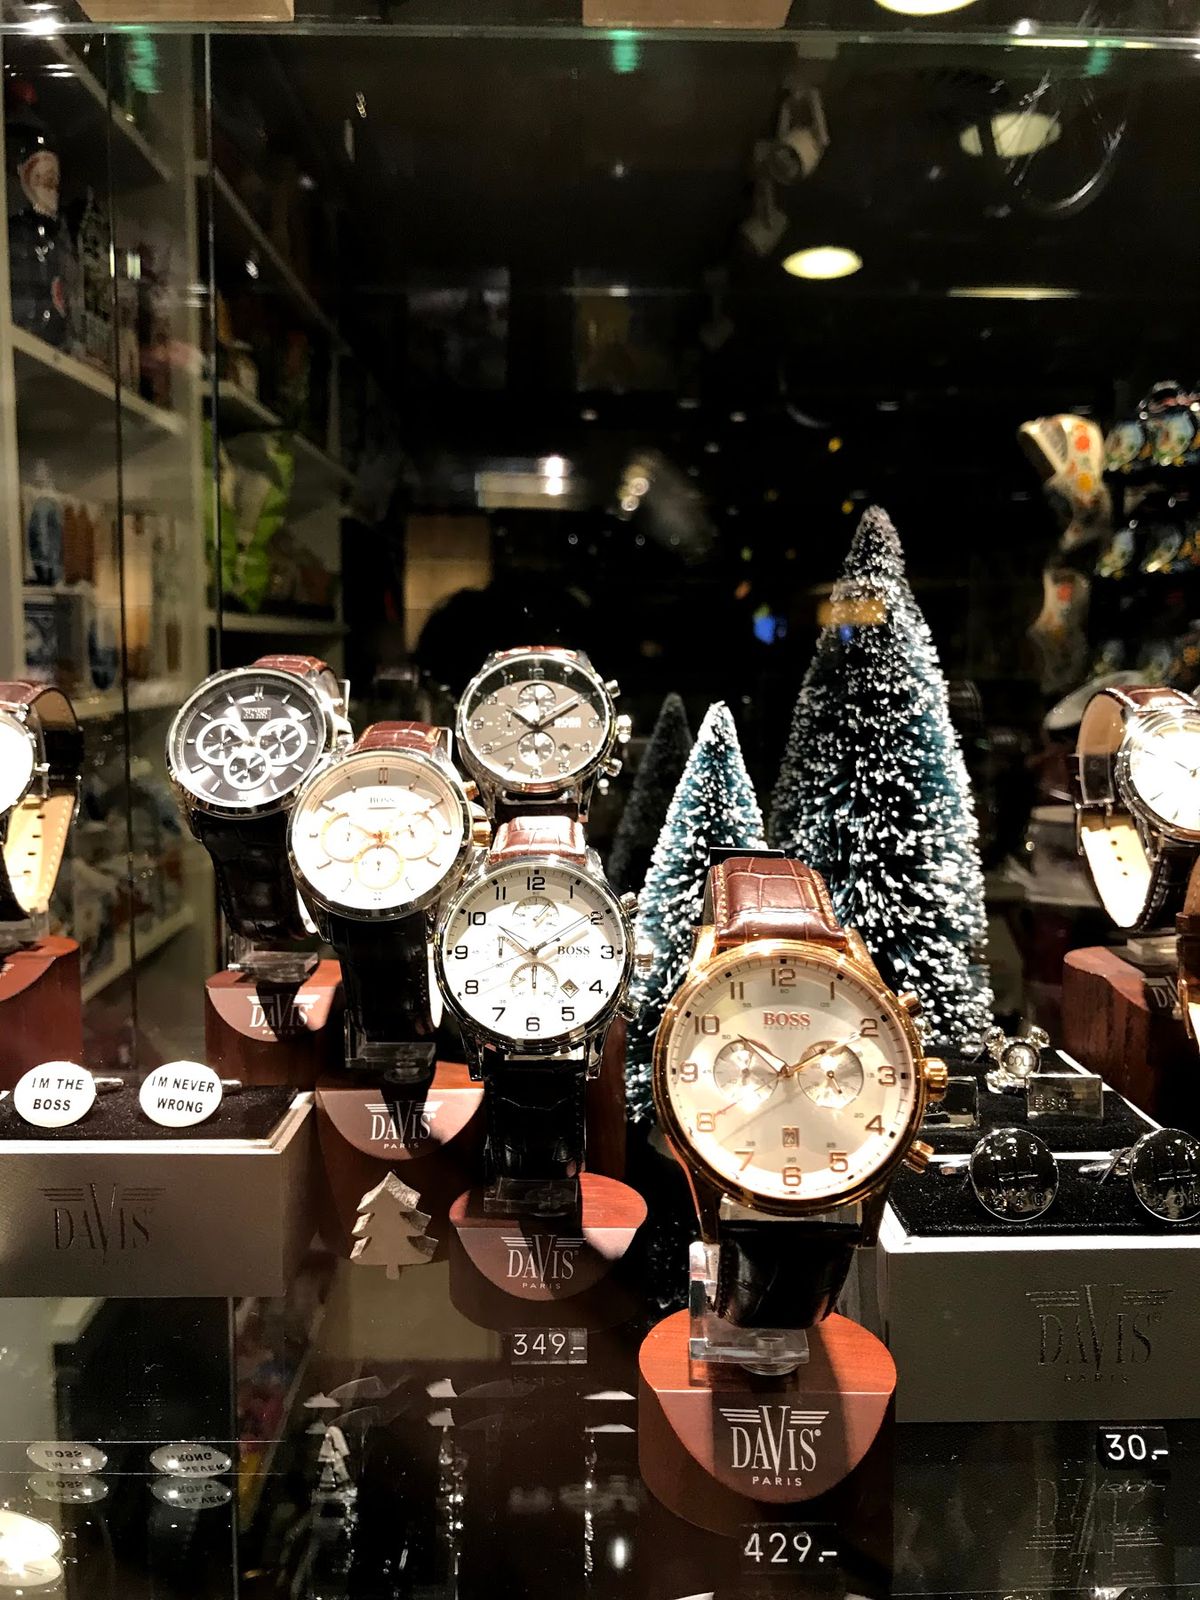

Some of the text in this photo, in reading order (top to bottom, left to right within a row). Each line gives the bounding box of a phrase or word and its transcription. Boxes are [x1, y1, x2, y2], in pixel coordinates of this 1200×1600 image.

[526, 876, 546, 891] 12
[495, 886, 507, 900] 11
[467, 911, 487, 926] 10
[590, 911, 605, 926] 2
[454, 945, 468, 960] 9
[557, 945, 591, 955] BOSS
[600, 945, 615, 960] 3
[770, 967, 797, 988] 12
[464, 979, 479, 995] 8
[588, 979, 604, 995] 4
[729, 981, 744, 1000] 11
[249, 993, 308, 1029] DAVIS
[491, 1006, 507, 1022] 7
[561, 1006, 575, 1022] 5
[762, 1011, 811, 1026] BOSS
[525, 1016, 540, 1032] 6
[694, 1014, 720, 1036] 10
[859, 1018, 880, 1038] 2
[680, 1062, 699, 1084] 9
[877, 1065, 898, 1086] 3
[57, 1078, 84, 1090] THE
[172, 1077, 215, 1093] NEVER
[32, 1098, 71, 1111] BOSS
[157, 1097, 204, 1114] WRONG
[369, 1100, 432, 1143] DAVIS
[697, 1111, 716, 1132] 8
[865, 1114, 886, 1136] 4
[734, 1150, 755, 1172] 7
[829, 1151, 849, 1173] 5
[782, 1166, 802, 1187] 6
[53, 1182, 150, 1255] DAVIS
[506, 1234, 575, 1282] DAVIS
[521, 1282, 561, 1290] PARIS
[1037, 1283, 1151, 1372] DAVIS
[730, 1405, 818, 1476] DAVIS
[1104, 1433, 1169, 1461] 30.-
[751, 1476, 803, 1487] PARIS
